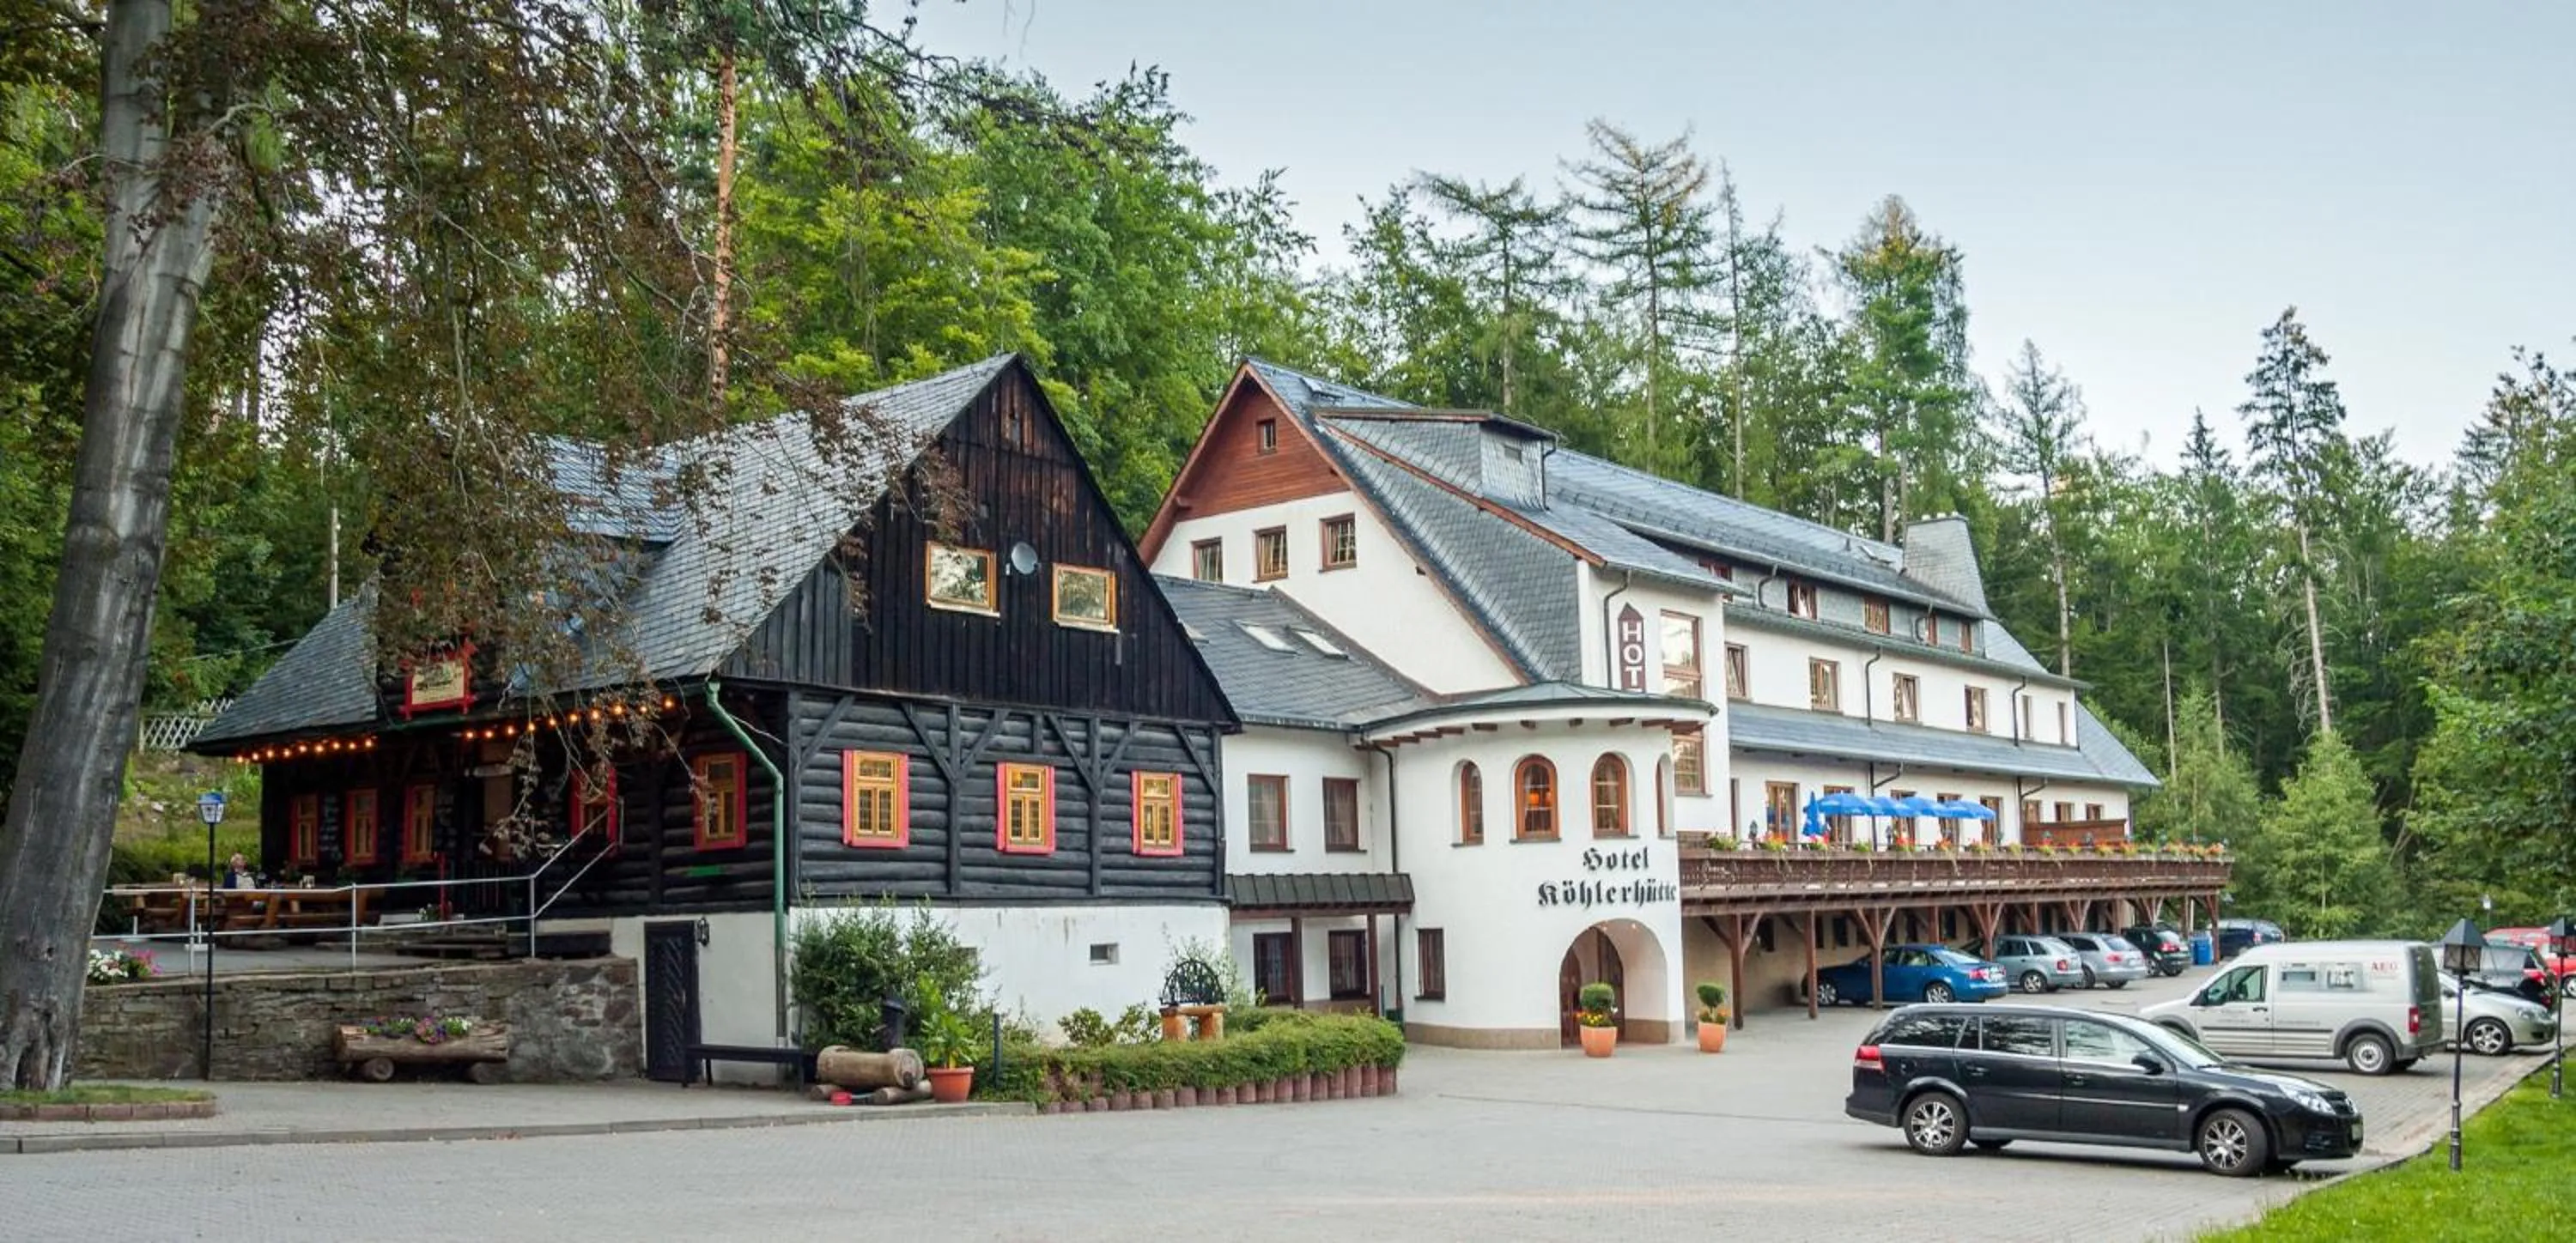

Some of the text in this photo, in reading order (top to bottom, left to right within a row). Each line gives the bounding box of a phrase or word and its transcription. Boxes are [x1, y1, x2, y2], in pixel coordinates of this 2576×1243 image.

[1622, 621, 1643, 692] HOT
[1583, 846, 1649, 871] Hotel
[1538, 878, 1677, 910] Köhlerhütte
